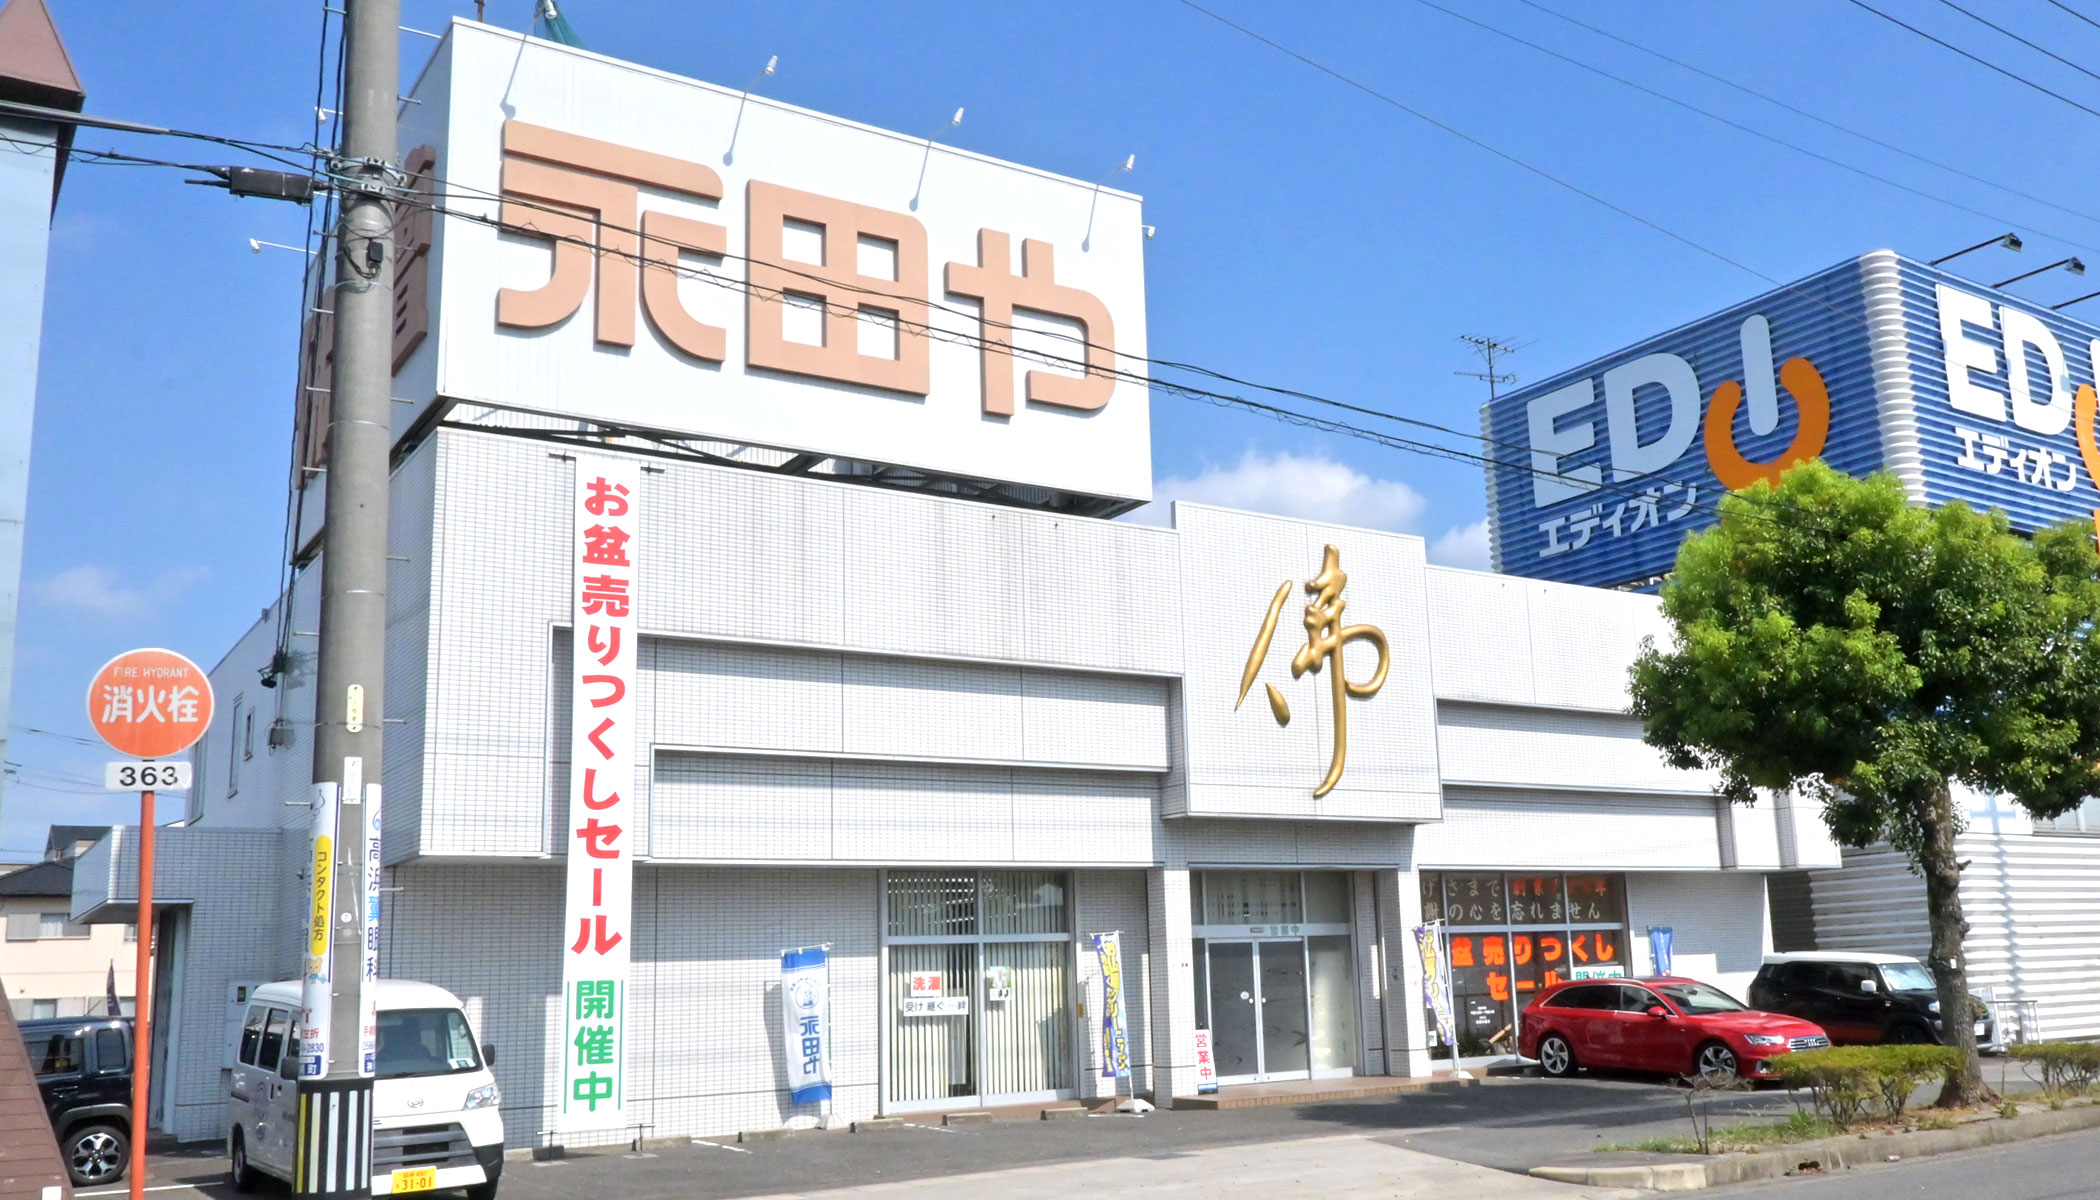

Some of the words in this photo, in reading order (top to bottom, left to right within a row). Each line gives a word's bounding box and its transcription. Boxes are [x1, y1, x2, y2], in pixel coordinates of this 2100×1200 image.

[1955, 427, 2077, 492] エディオン
[1539, 481, 1697, 558] エディオン
[143, 667, 190, 679] HYDRANT
[101, 684, 199, 724] 消火栓
[571, 476, 631, 956] お盆売りつくしセール
[119, 766, 178, 787] 363
[313, 851, 328, 941] コンタクト処方
[573, 979, 615, 1112] 開催中
[1195, 1033, 1212, 1081] 営業中
[402, 1177, 432, 1190] 31-01
